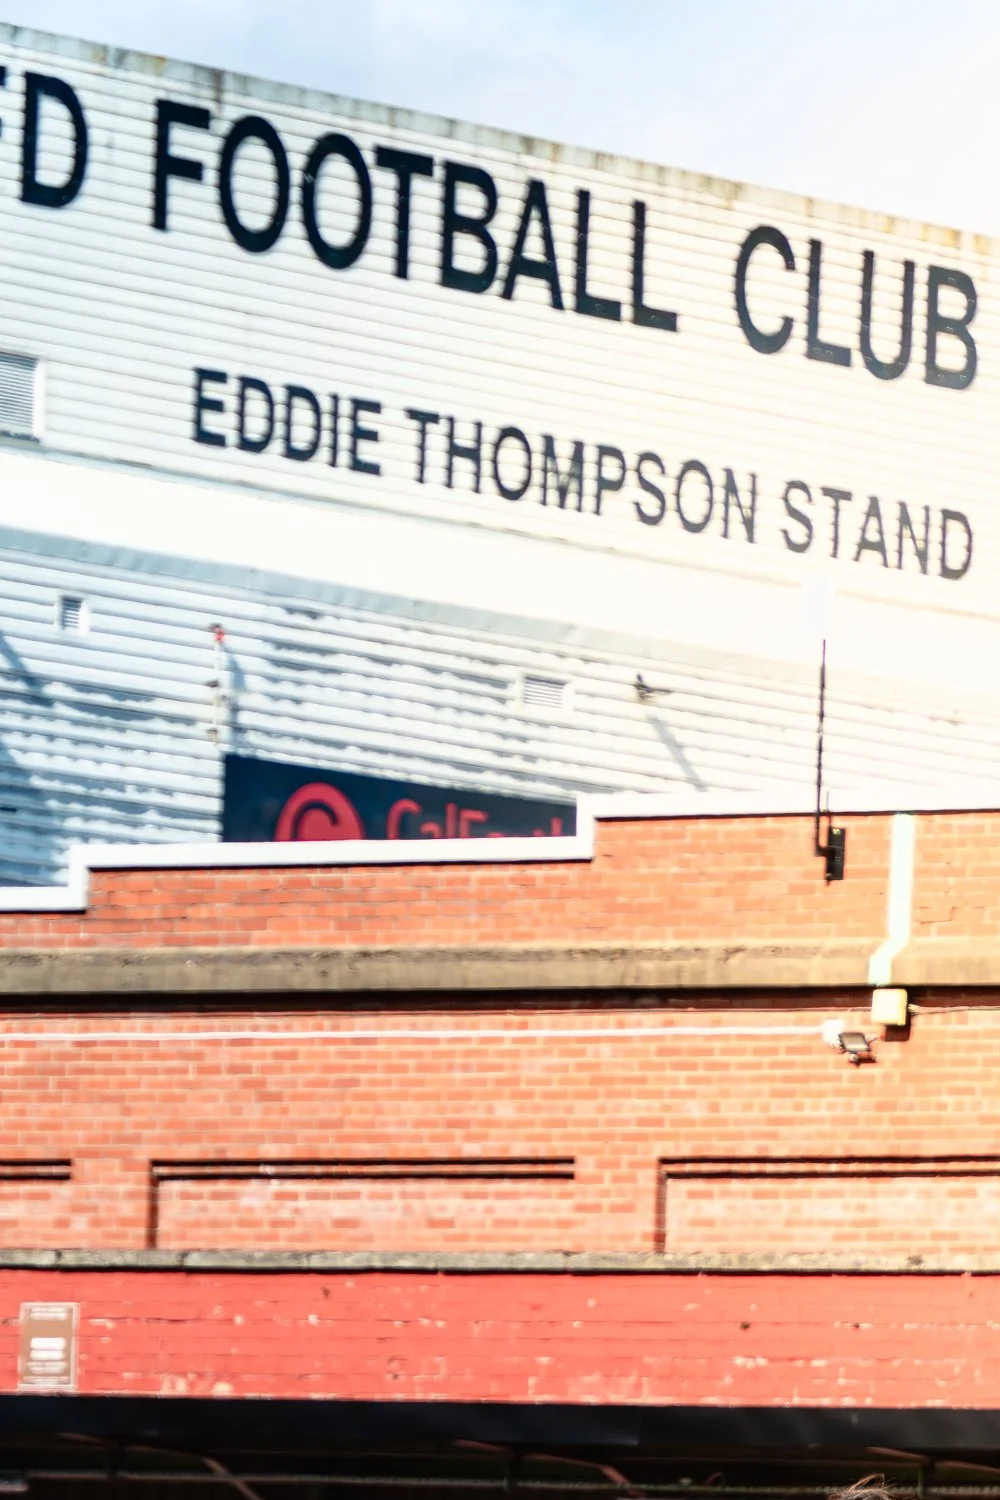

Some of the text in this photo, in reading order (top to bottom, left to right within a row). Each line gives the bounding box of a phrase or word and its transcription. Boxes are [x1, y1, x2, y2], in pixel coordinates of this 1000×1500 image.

[149, 98, 678, 333] FOOTBALL
[733, 225, 980, 392] CLUB
[192, 367, 974, 582] EDDIE THOMPSON STAND
